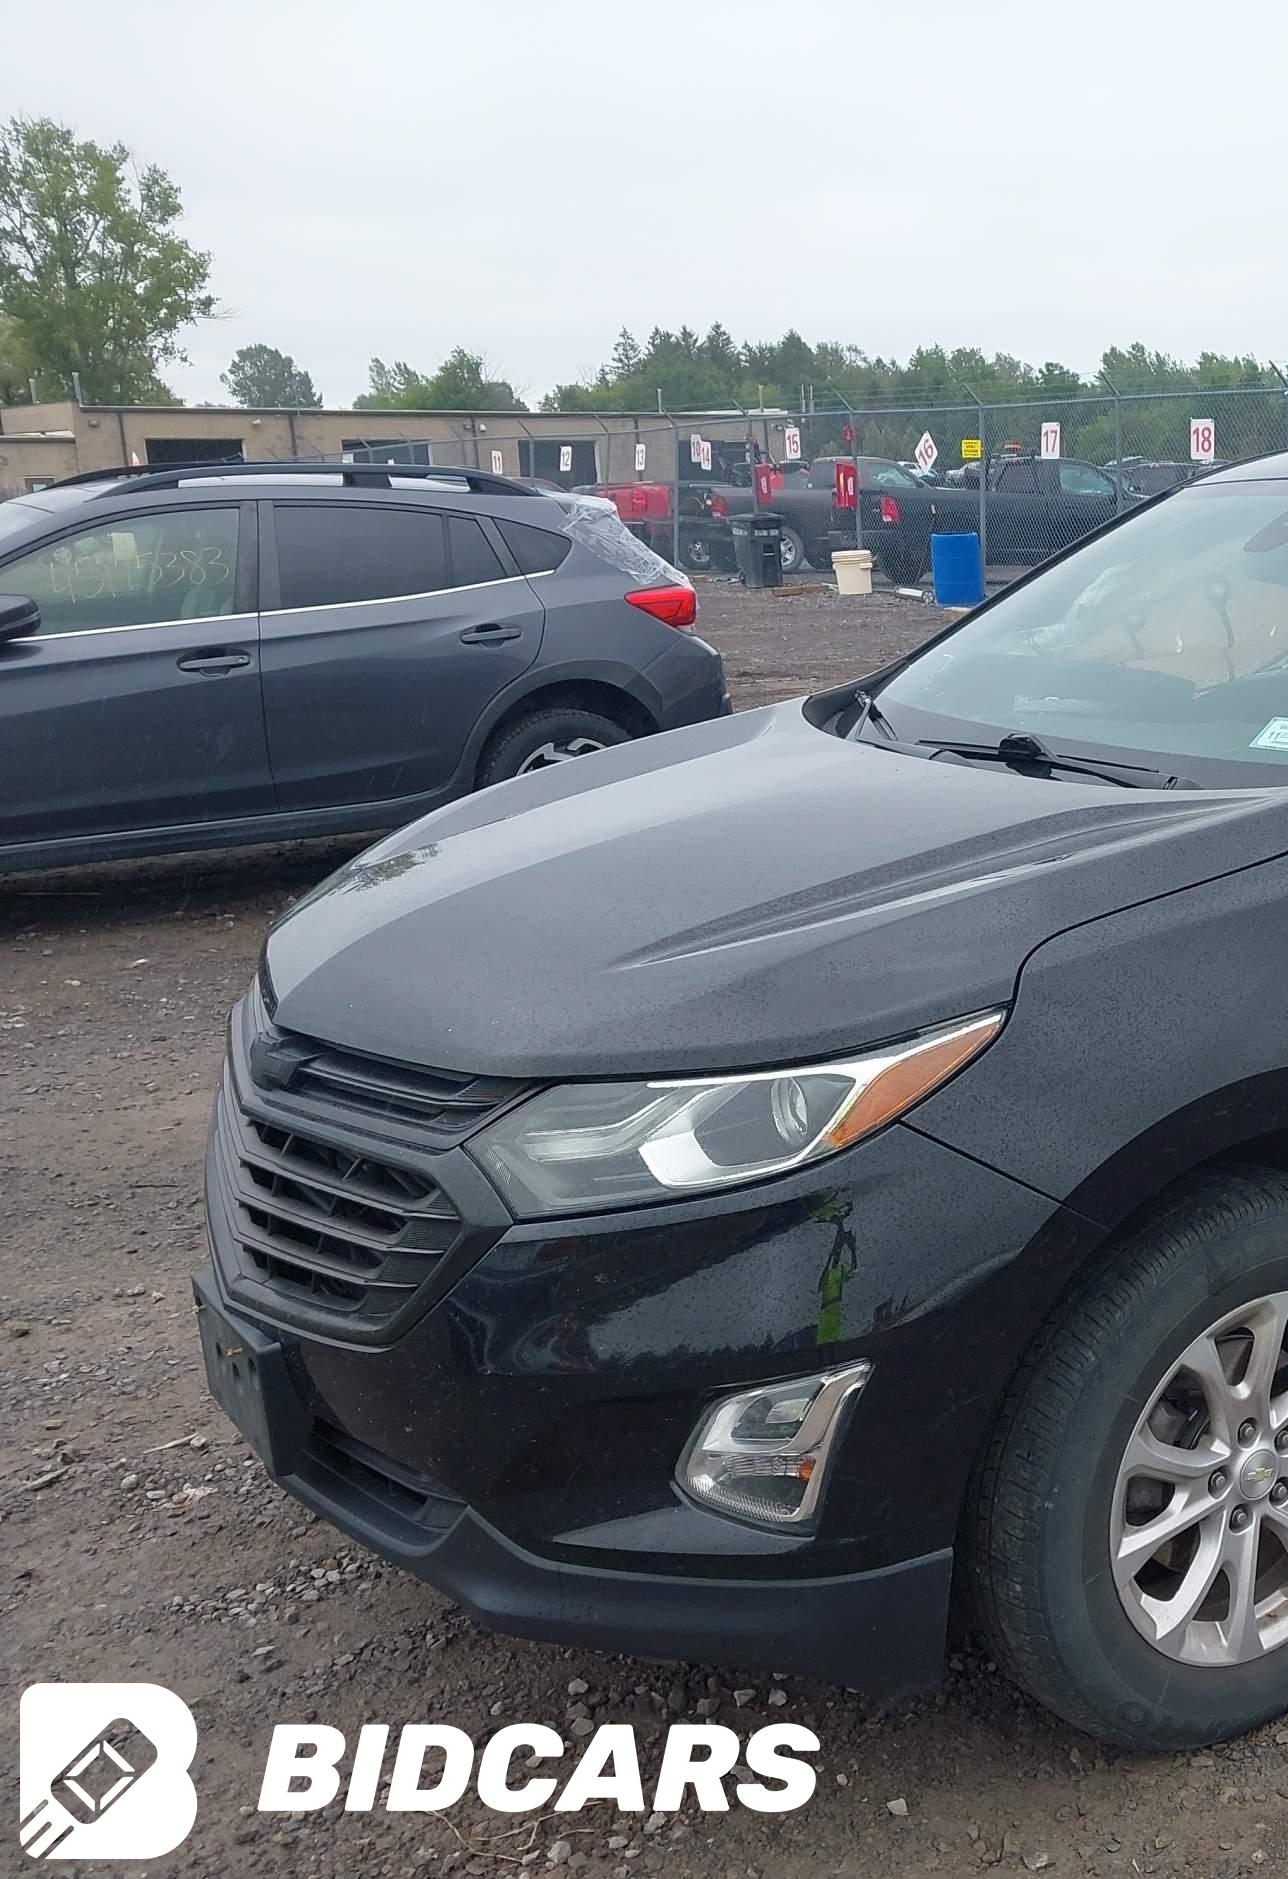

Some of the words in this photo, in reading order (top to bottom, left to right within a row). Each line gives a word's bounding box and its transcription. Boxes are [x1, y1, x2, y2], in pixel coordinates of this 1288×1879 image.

[786, 433, 800, 455] 15
[1042, 429, 1058, 453] 17
[1191, 426, 1212, 453] 18
[560, 450, 571, 466] 12
[636, 450, 645, 466] 13
[701, 447, 711, 465] 14
[917, 438, 935, 464] 16
[493, 455, 502, 472] 11
